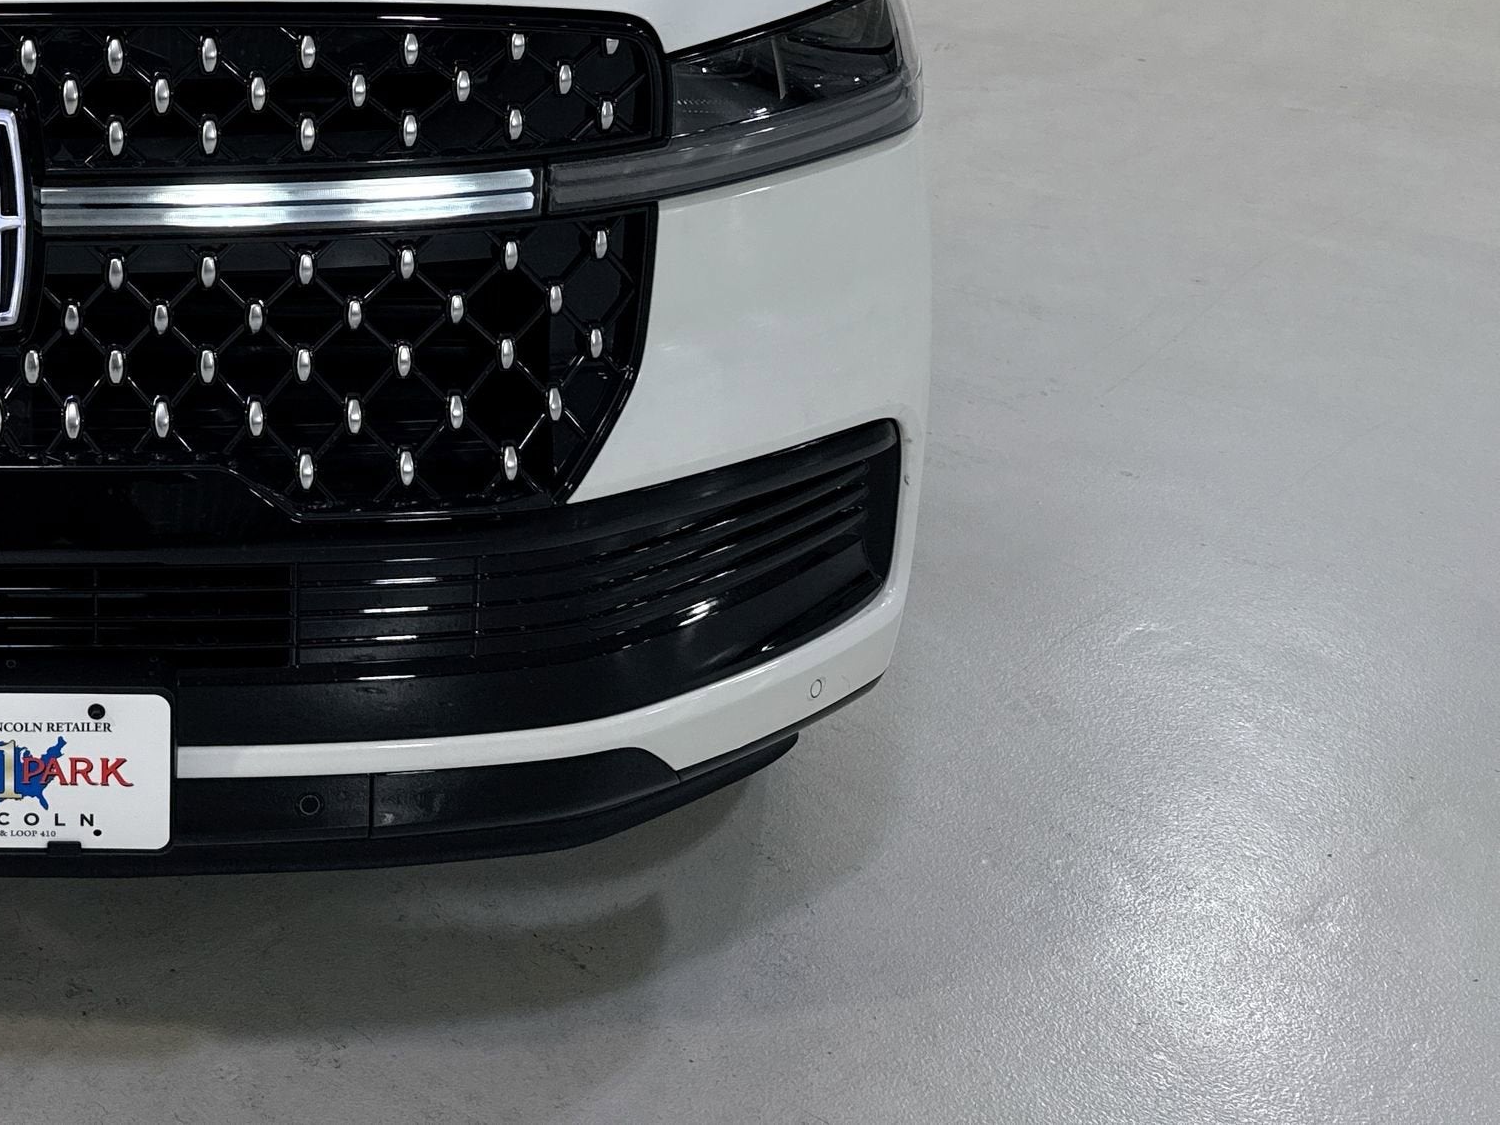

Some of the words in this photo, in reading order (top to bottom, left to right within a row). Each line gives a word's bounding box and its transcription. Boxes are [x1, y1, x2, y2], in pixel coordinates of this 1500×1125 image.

[46, 722, 112, 733] RETAILER
[21, 755, 134, 787] PARK
[0, 829, 8, 838] &
[10, 830, 38, 838] LOOP
[40, 830, 57, 838] 410
